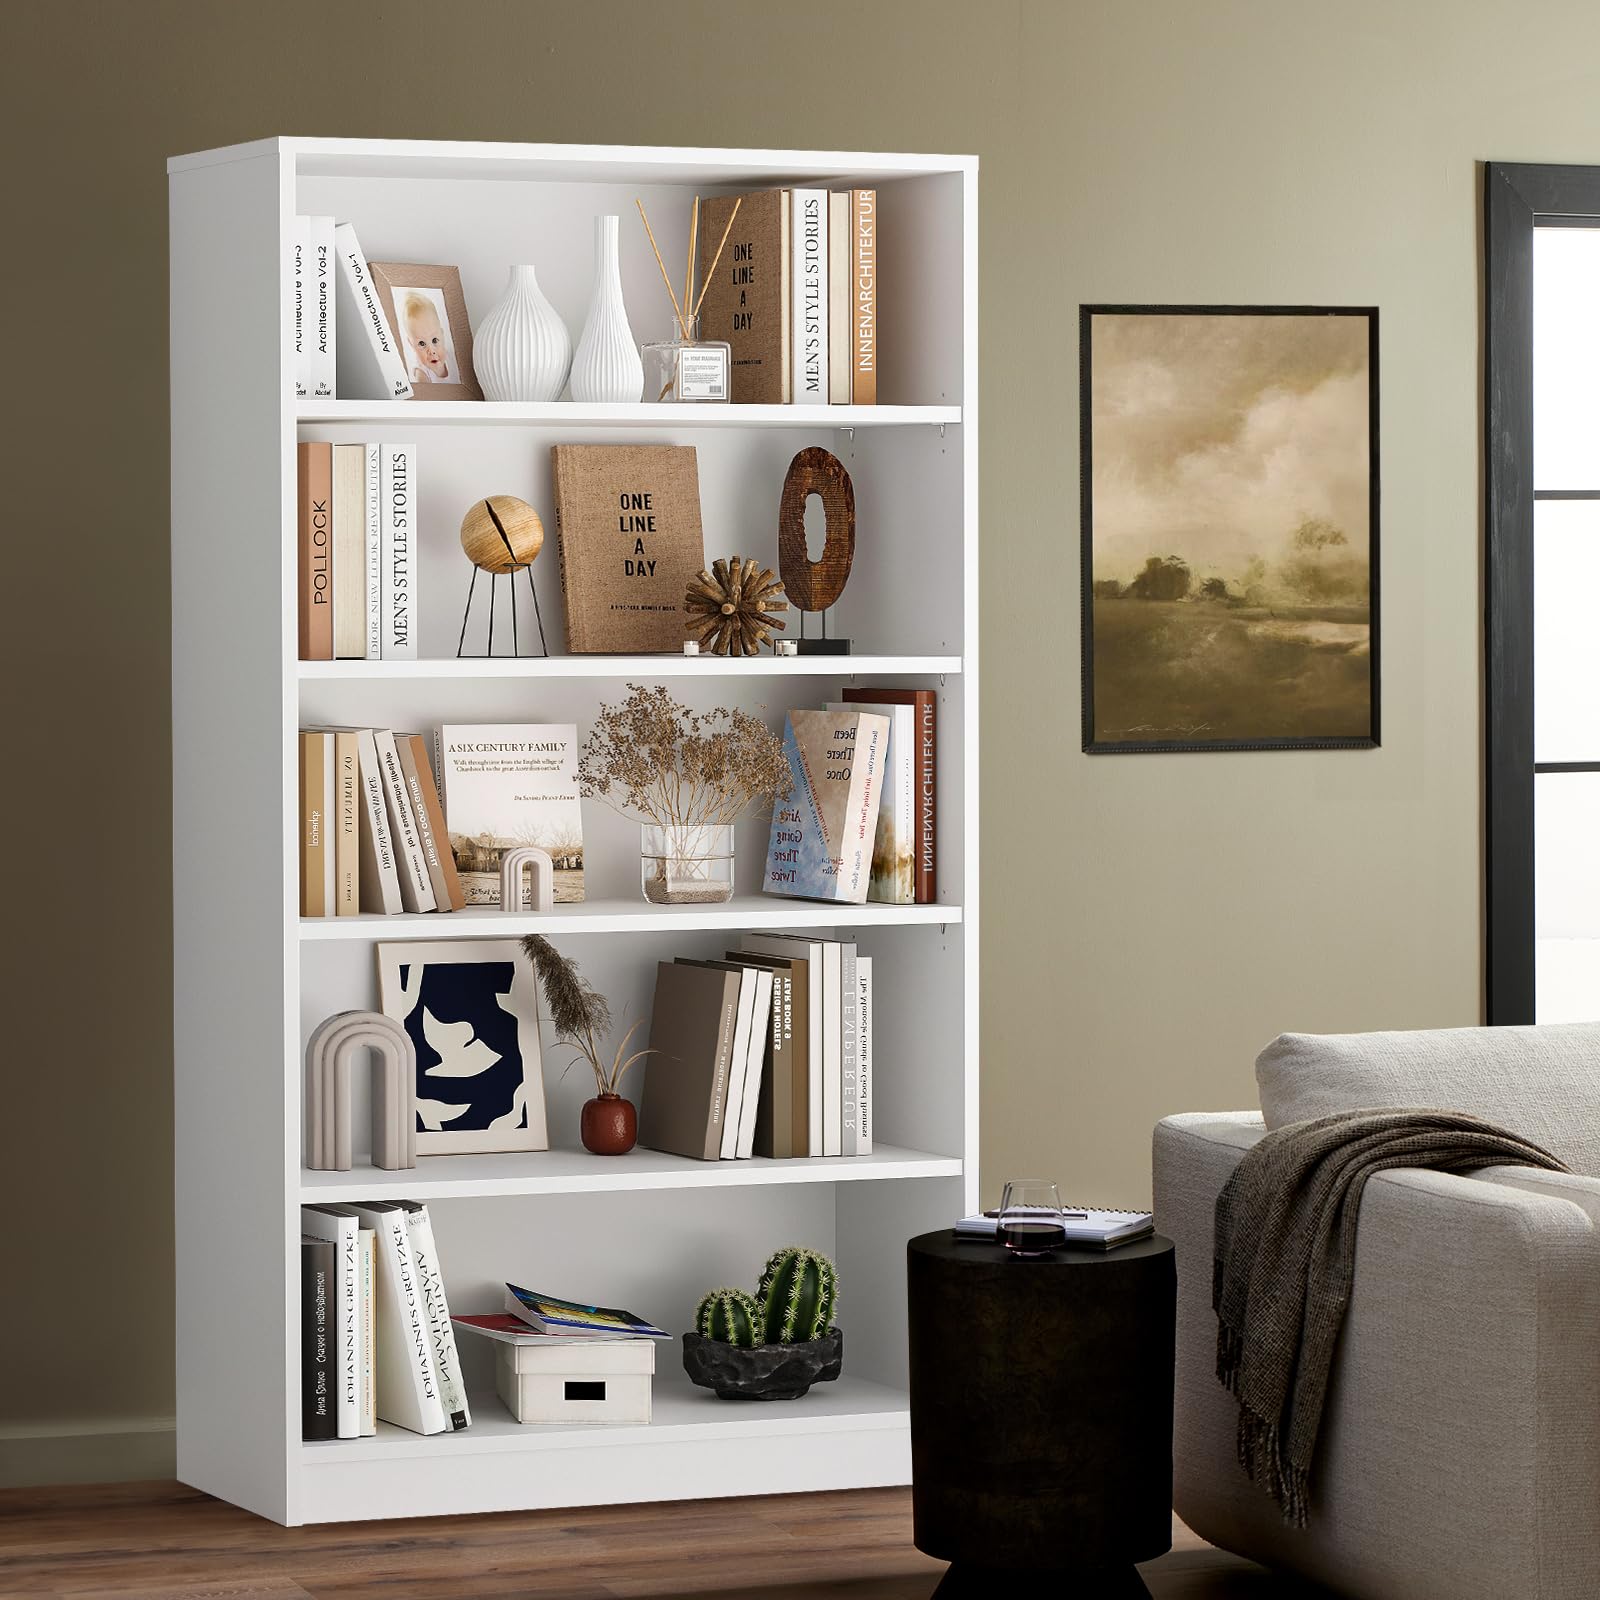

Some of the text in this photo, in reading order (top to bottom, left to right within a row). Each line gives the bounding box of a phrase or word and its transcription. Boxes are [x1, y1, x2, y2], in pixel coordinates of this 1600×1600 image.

[734, 243, 753, 261] ONE
[348, 253, 365, 284] Vol-1
[732, 267, 754, 285] LINE
[859, 190, 873, 372] INNENARCHITEKTUR
[318, 245, 327, 354] Architecture Vol-2
[740, 291, 746, 308] A
[805, 199, 819, 393] MEN'S STYLE STORIES
[733, 313, 753, 331] DAY
[370, 449, 378, 537] REVOLUTION
[620, 493, 653, 510] ONE
[619, 515, 657, 532] LINE
[313, 500, 328, 604] POLLOCK
[370, 541, 378, 578] LOOK
[392, 453, 408, 647] MEN'S STYLE STORIES
[634, 538, 645, 554] A
[624, 559, 657, 577] DAY
[370, 583, 378, 614] NEW
[448, 742, 568, 753] A SIX CENTURY FAMILY
[346, 1230, 355, 1406] JOHANNES GRÜTZKE
[392, 1225, 435, 1400] JOHANNES GRÜTZKE
[316, 1334, 327, 1363] Сказки
[316, 1396, 327, 1416] Анна
